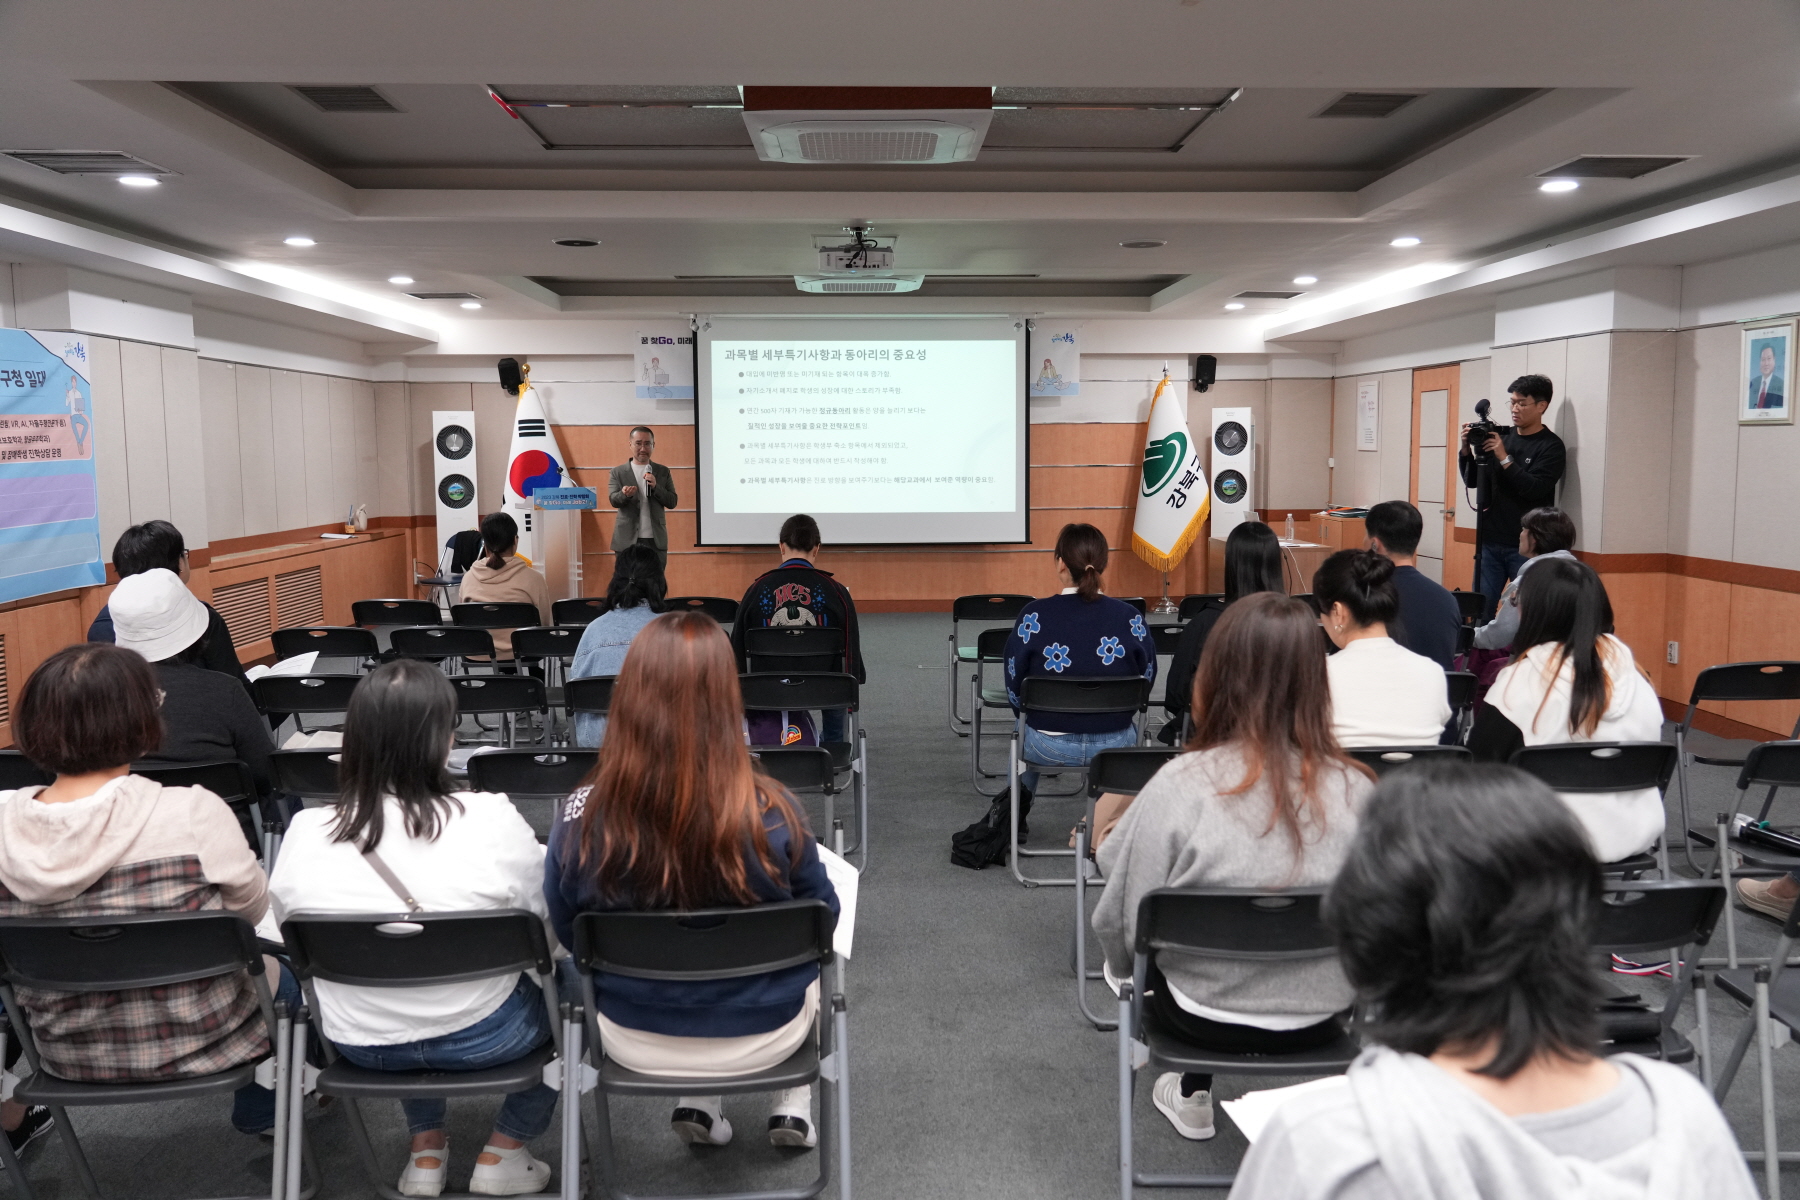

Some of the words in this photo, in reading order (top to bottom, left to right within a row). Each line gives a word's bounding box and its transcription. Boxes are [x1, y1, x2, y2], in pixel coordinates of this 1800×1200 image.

[641, 336, 648, 345] 꿈
[724, 349, 758, 361] 과목별
[762, 349, 842, 361] 세부특기사항과
[844, 349, 890, 361] 동아리의
[893, 349, 927, 361] 중요성
[787, 370, 799, 378] 또는
[801, 370, 820, 378] 미기재
[822, 370, 834, 378] 되는
[0, 369, 25, 388] 구청
[746, 387, 778, 395] 자기소개서
[800, 387, 819, 395] 학생의
[821, 387, 840, 395] 성장에
[842, 387, 854, 395] 대한
[855, 387, 881, 395] 스토리가
[778, 407, 797, 415] 기재가
[799, 407, 818, 415] 가능한
[907, 407, 926, 415] 보다는
[747, 442, 766, 450] 과목별
[834, 457, 852, 465] 반드시
[773, 583, 811, 611] MC5
